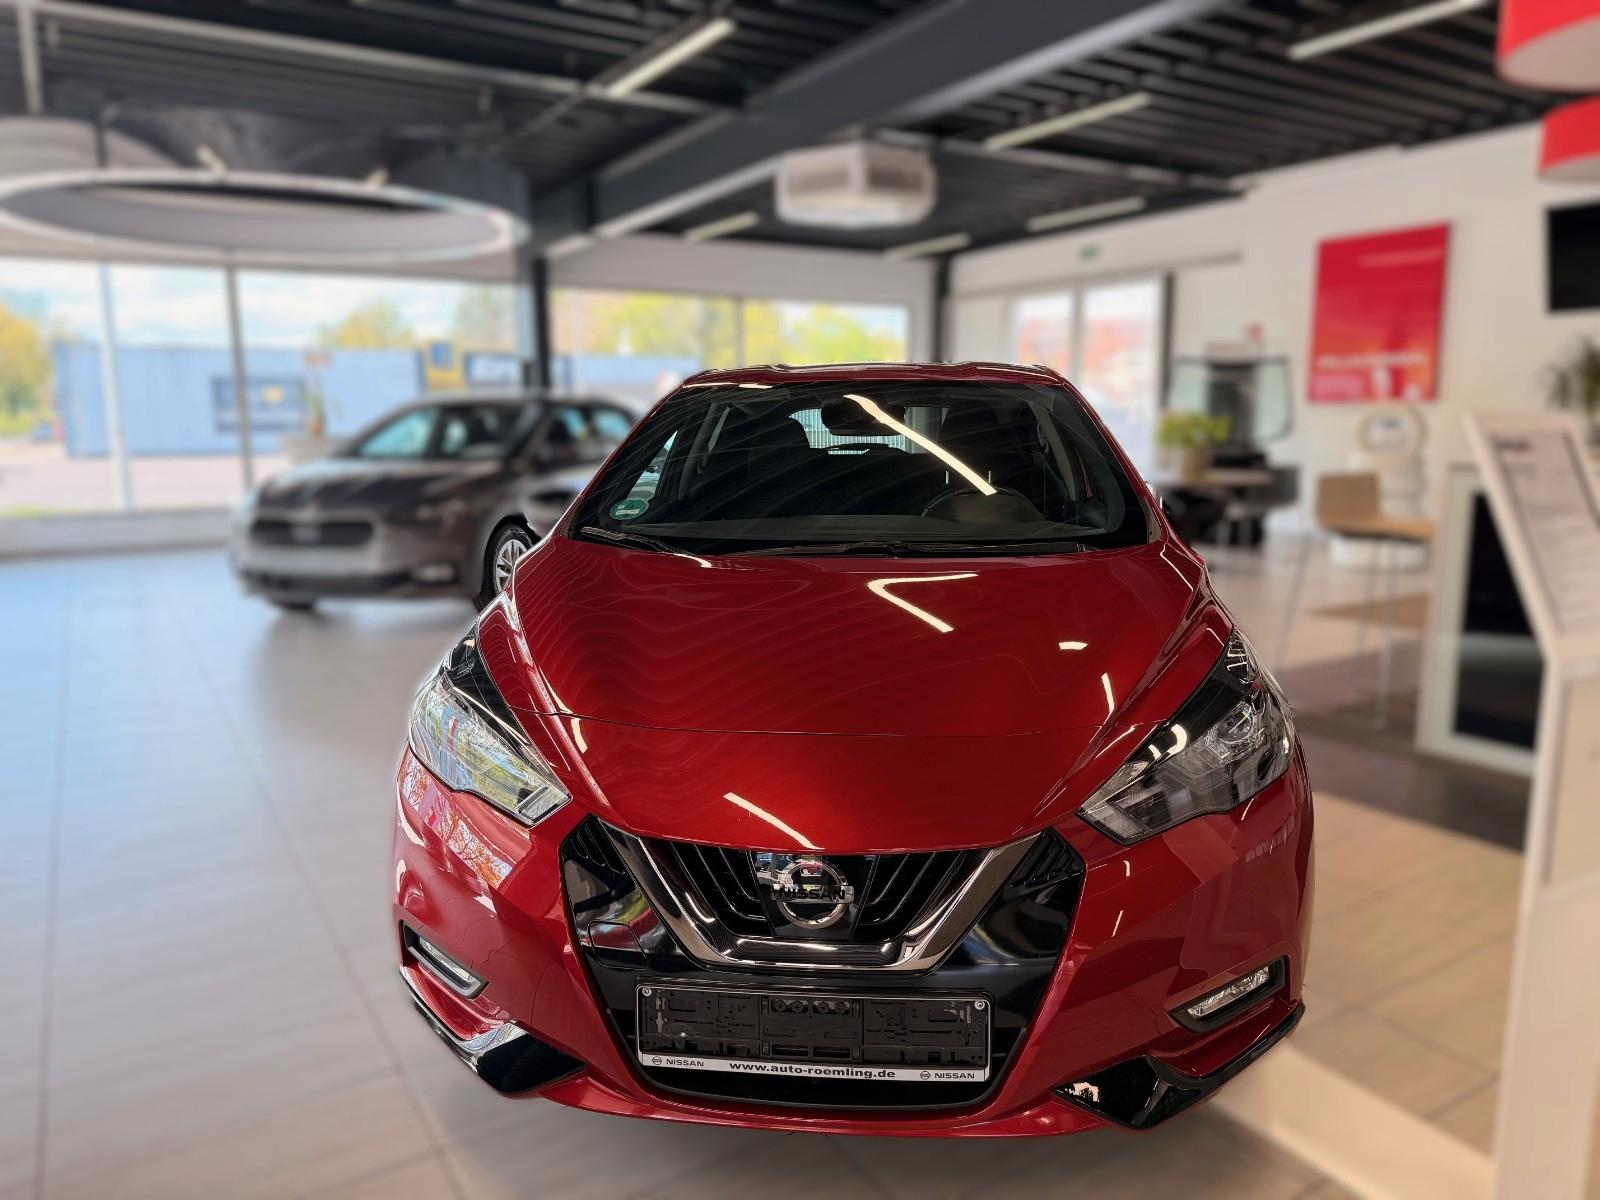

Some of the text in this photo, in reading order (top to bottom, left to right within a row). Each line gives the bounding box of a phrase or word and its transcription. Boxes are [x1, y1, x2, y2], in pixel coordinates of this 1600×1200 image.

[778, 888, 846, 900] NISSAN
[666, 1058, 975, 1080] NISSAN www.auto-roemling.de NISSAN
